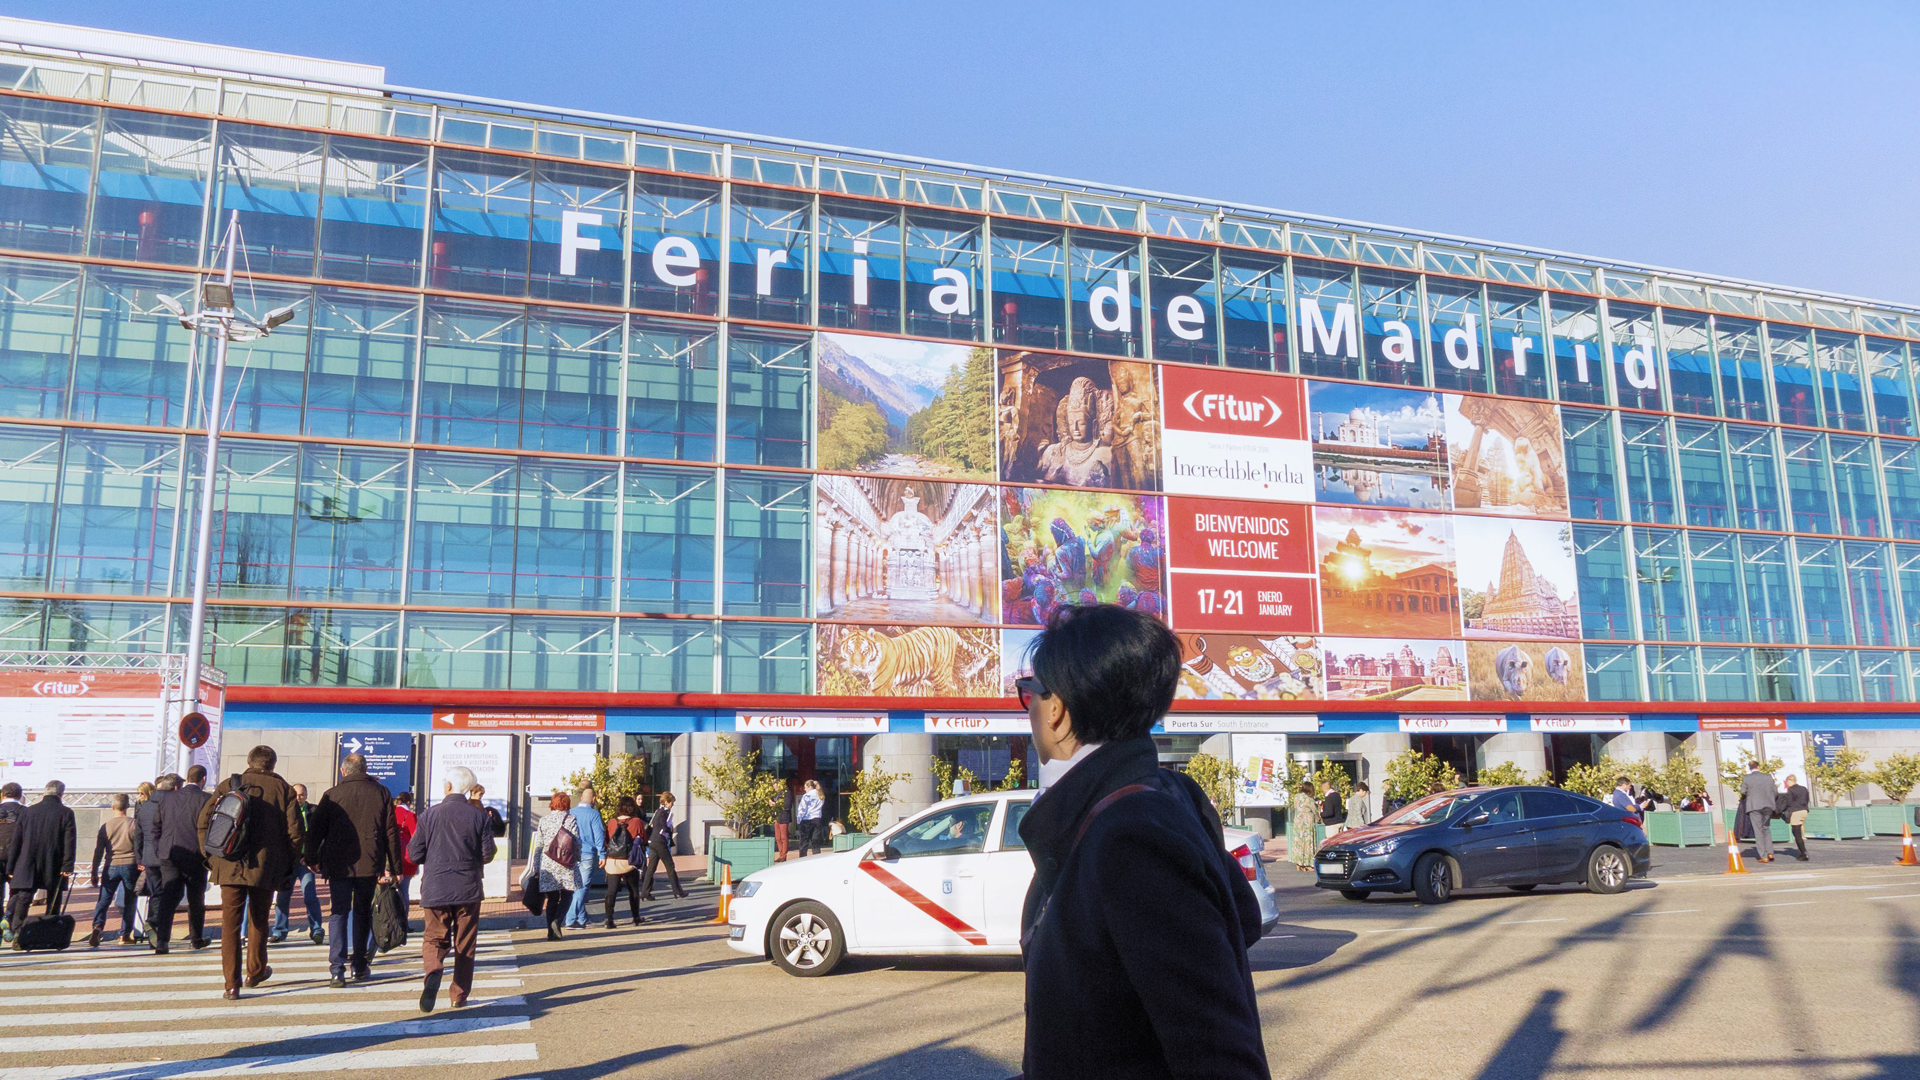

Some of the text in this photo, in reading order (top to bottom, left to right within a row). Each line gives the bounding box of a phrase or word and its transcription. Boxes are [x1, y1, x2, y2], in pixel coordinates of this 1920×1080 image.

[560, 210, 1657, 390] Feria de Madrid
[1195, 513, 1290, 536] BIENVENIDOS
[1208, 538, 1280, 560] WELCOME
[1197, 589, 1243, 615] 17-21
[1257, 591, 1283, 603] ENERO
[1259, 604, 1293, 616] JANUARY
[1172, 721, 1198, 729] Puerta
